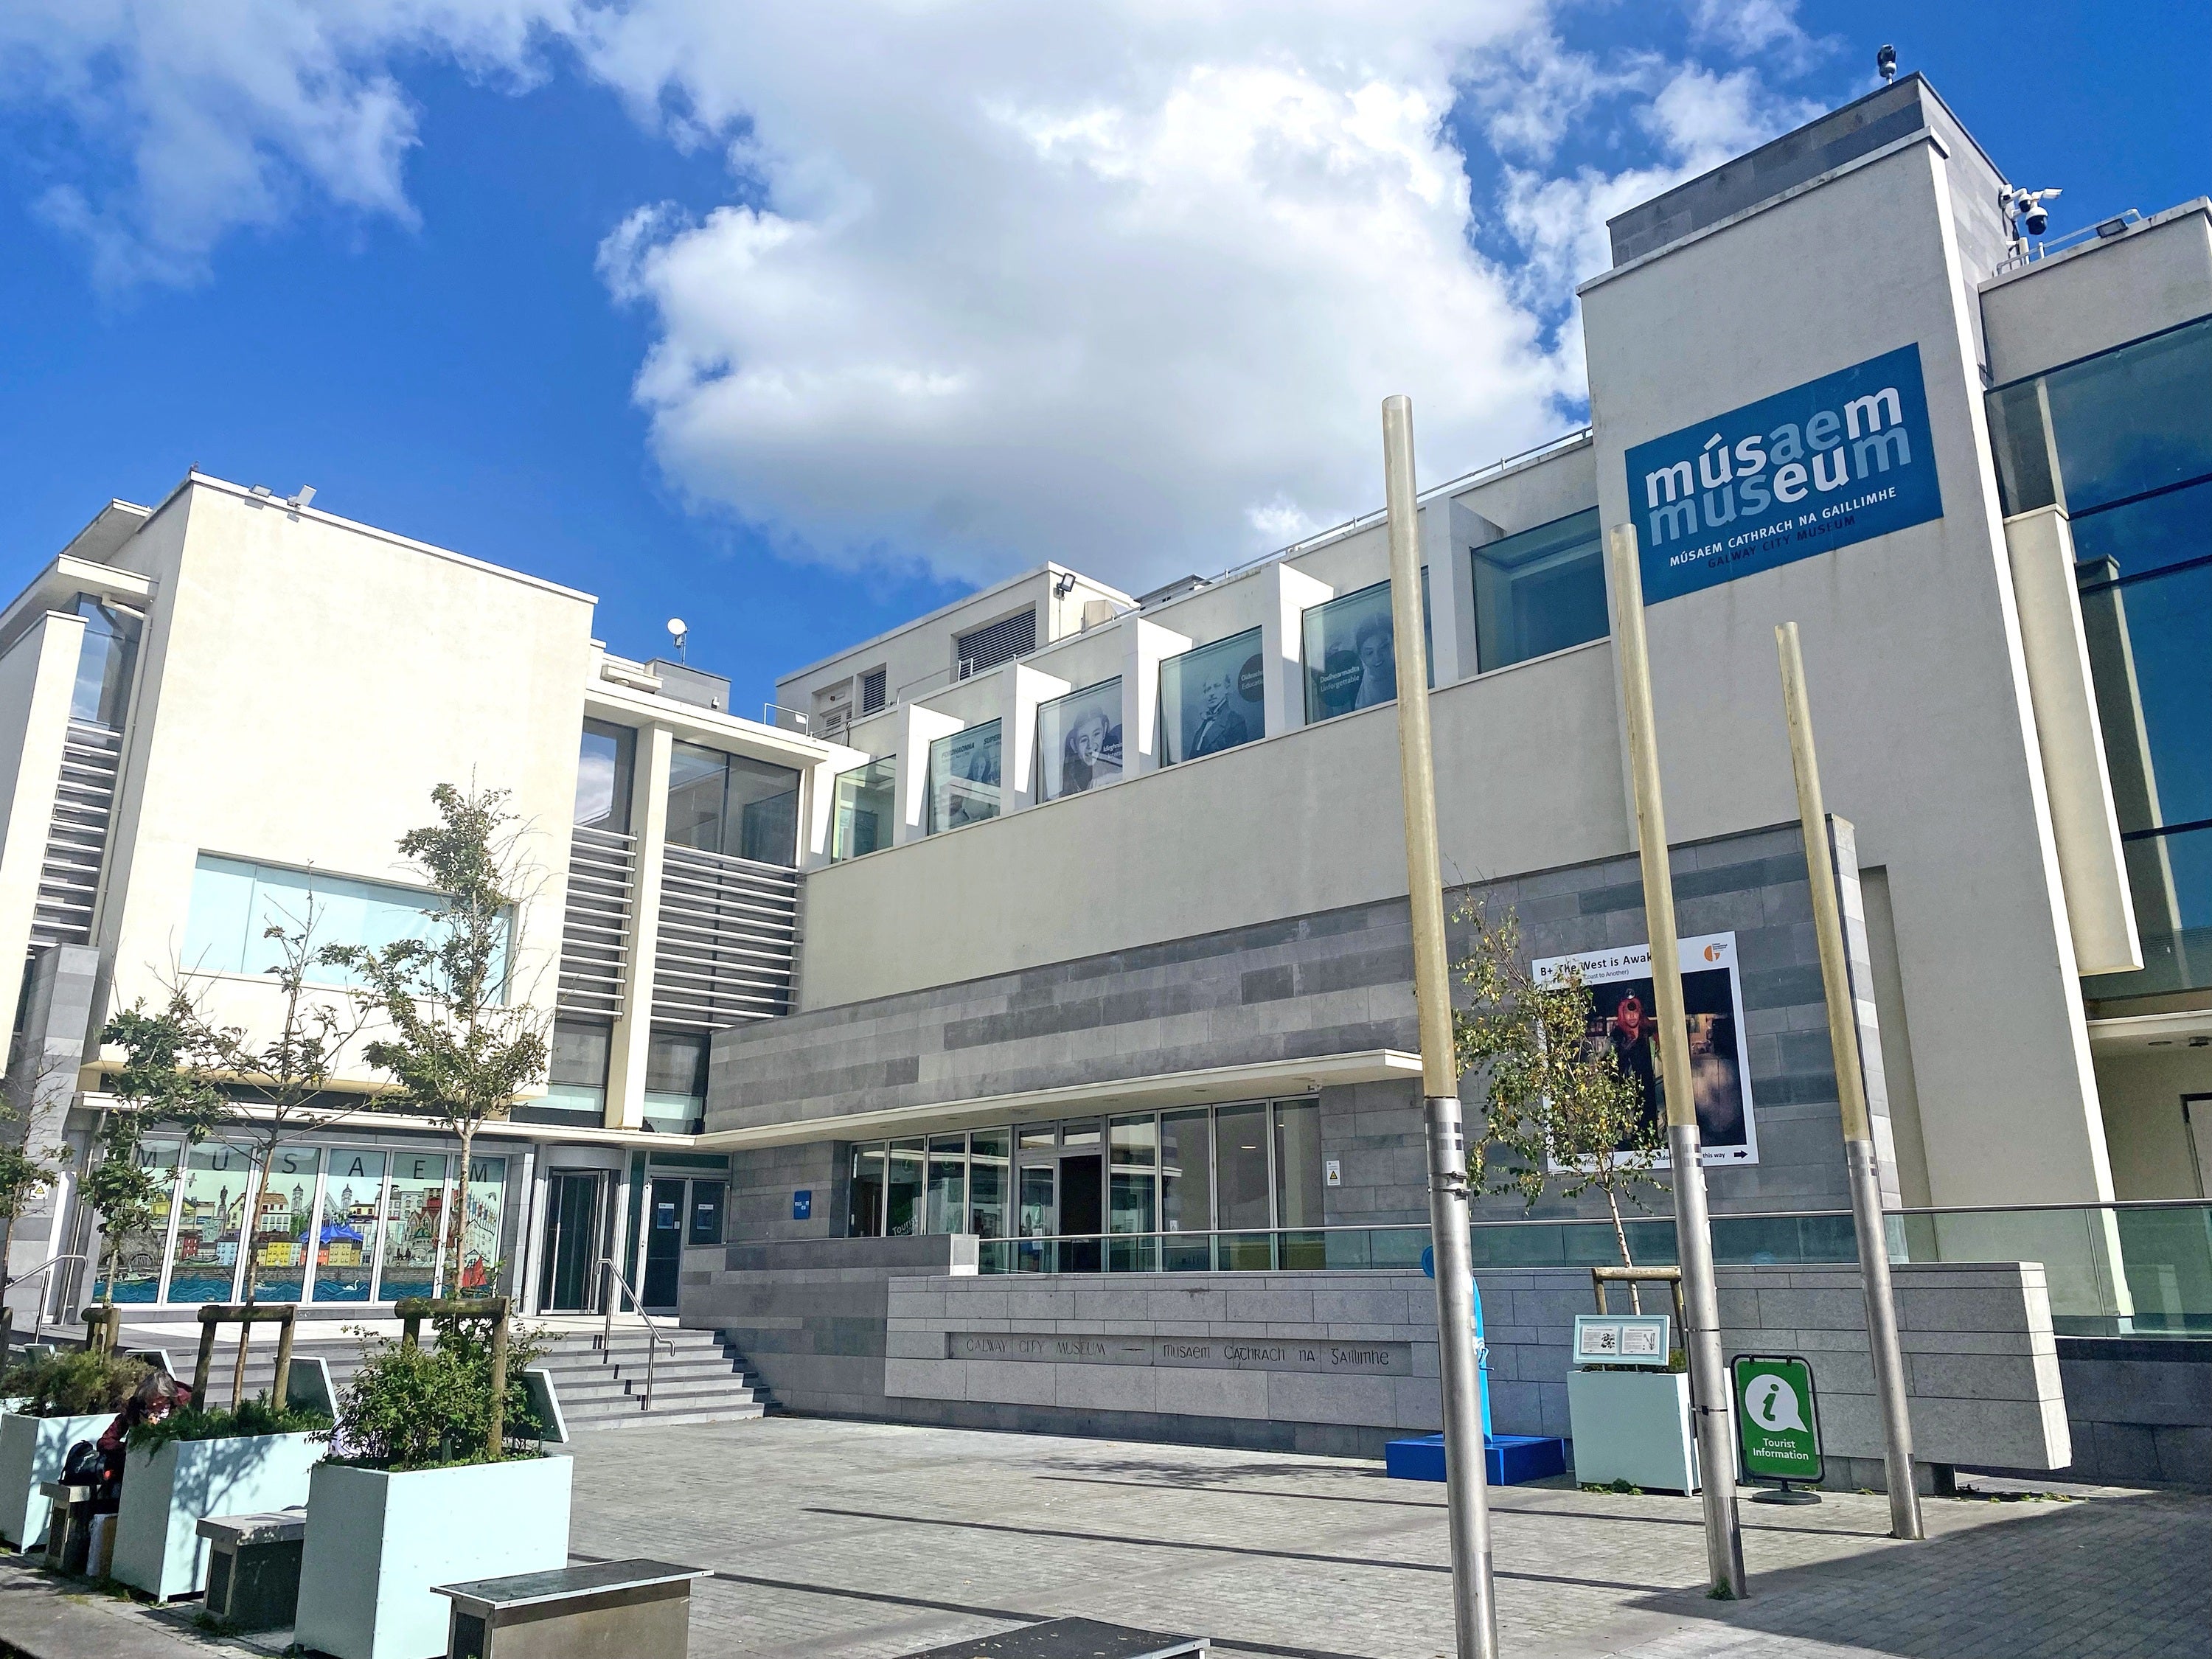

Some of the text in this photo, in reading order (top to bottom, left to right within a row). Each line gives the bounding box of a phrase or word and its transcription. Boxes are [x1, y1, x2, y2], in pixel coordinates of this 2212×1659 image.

[1645, 387, 1902, 508] músaem
[1649, 427, 1912, 546] museum
[1669, 487, 1896, 567] MÚSAEM CATHRACH NA GAILLIMHE
[1708, 515, 1856, 568] GALWAY CITY MUSEUM
[1320, 675, 1360, 692] Unforgettable
[1540, 967, 1553, 976] B+
[1581, 959, 1607, 971] West
[1610, 957, 1618, 967] is
[1606, 969, 1629, 978] Another)
[966, 1338, 1007, 1353] GALWAY
[1019, 1340, 1044, 1354] CITY
[1056, 1340, 1106, 1355] MUSEUM
[1762, 1438, 1796, 1448] Tourist
[1753, 1447, 1809, 1461] Information
